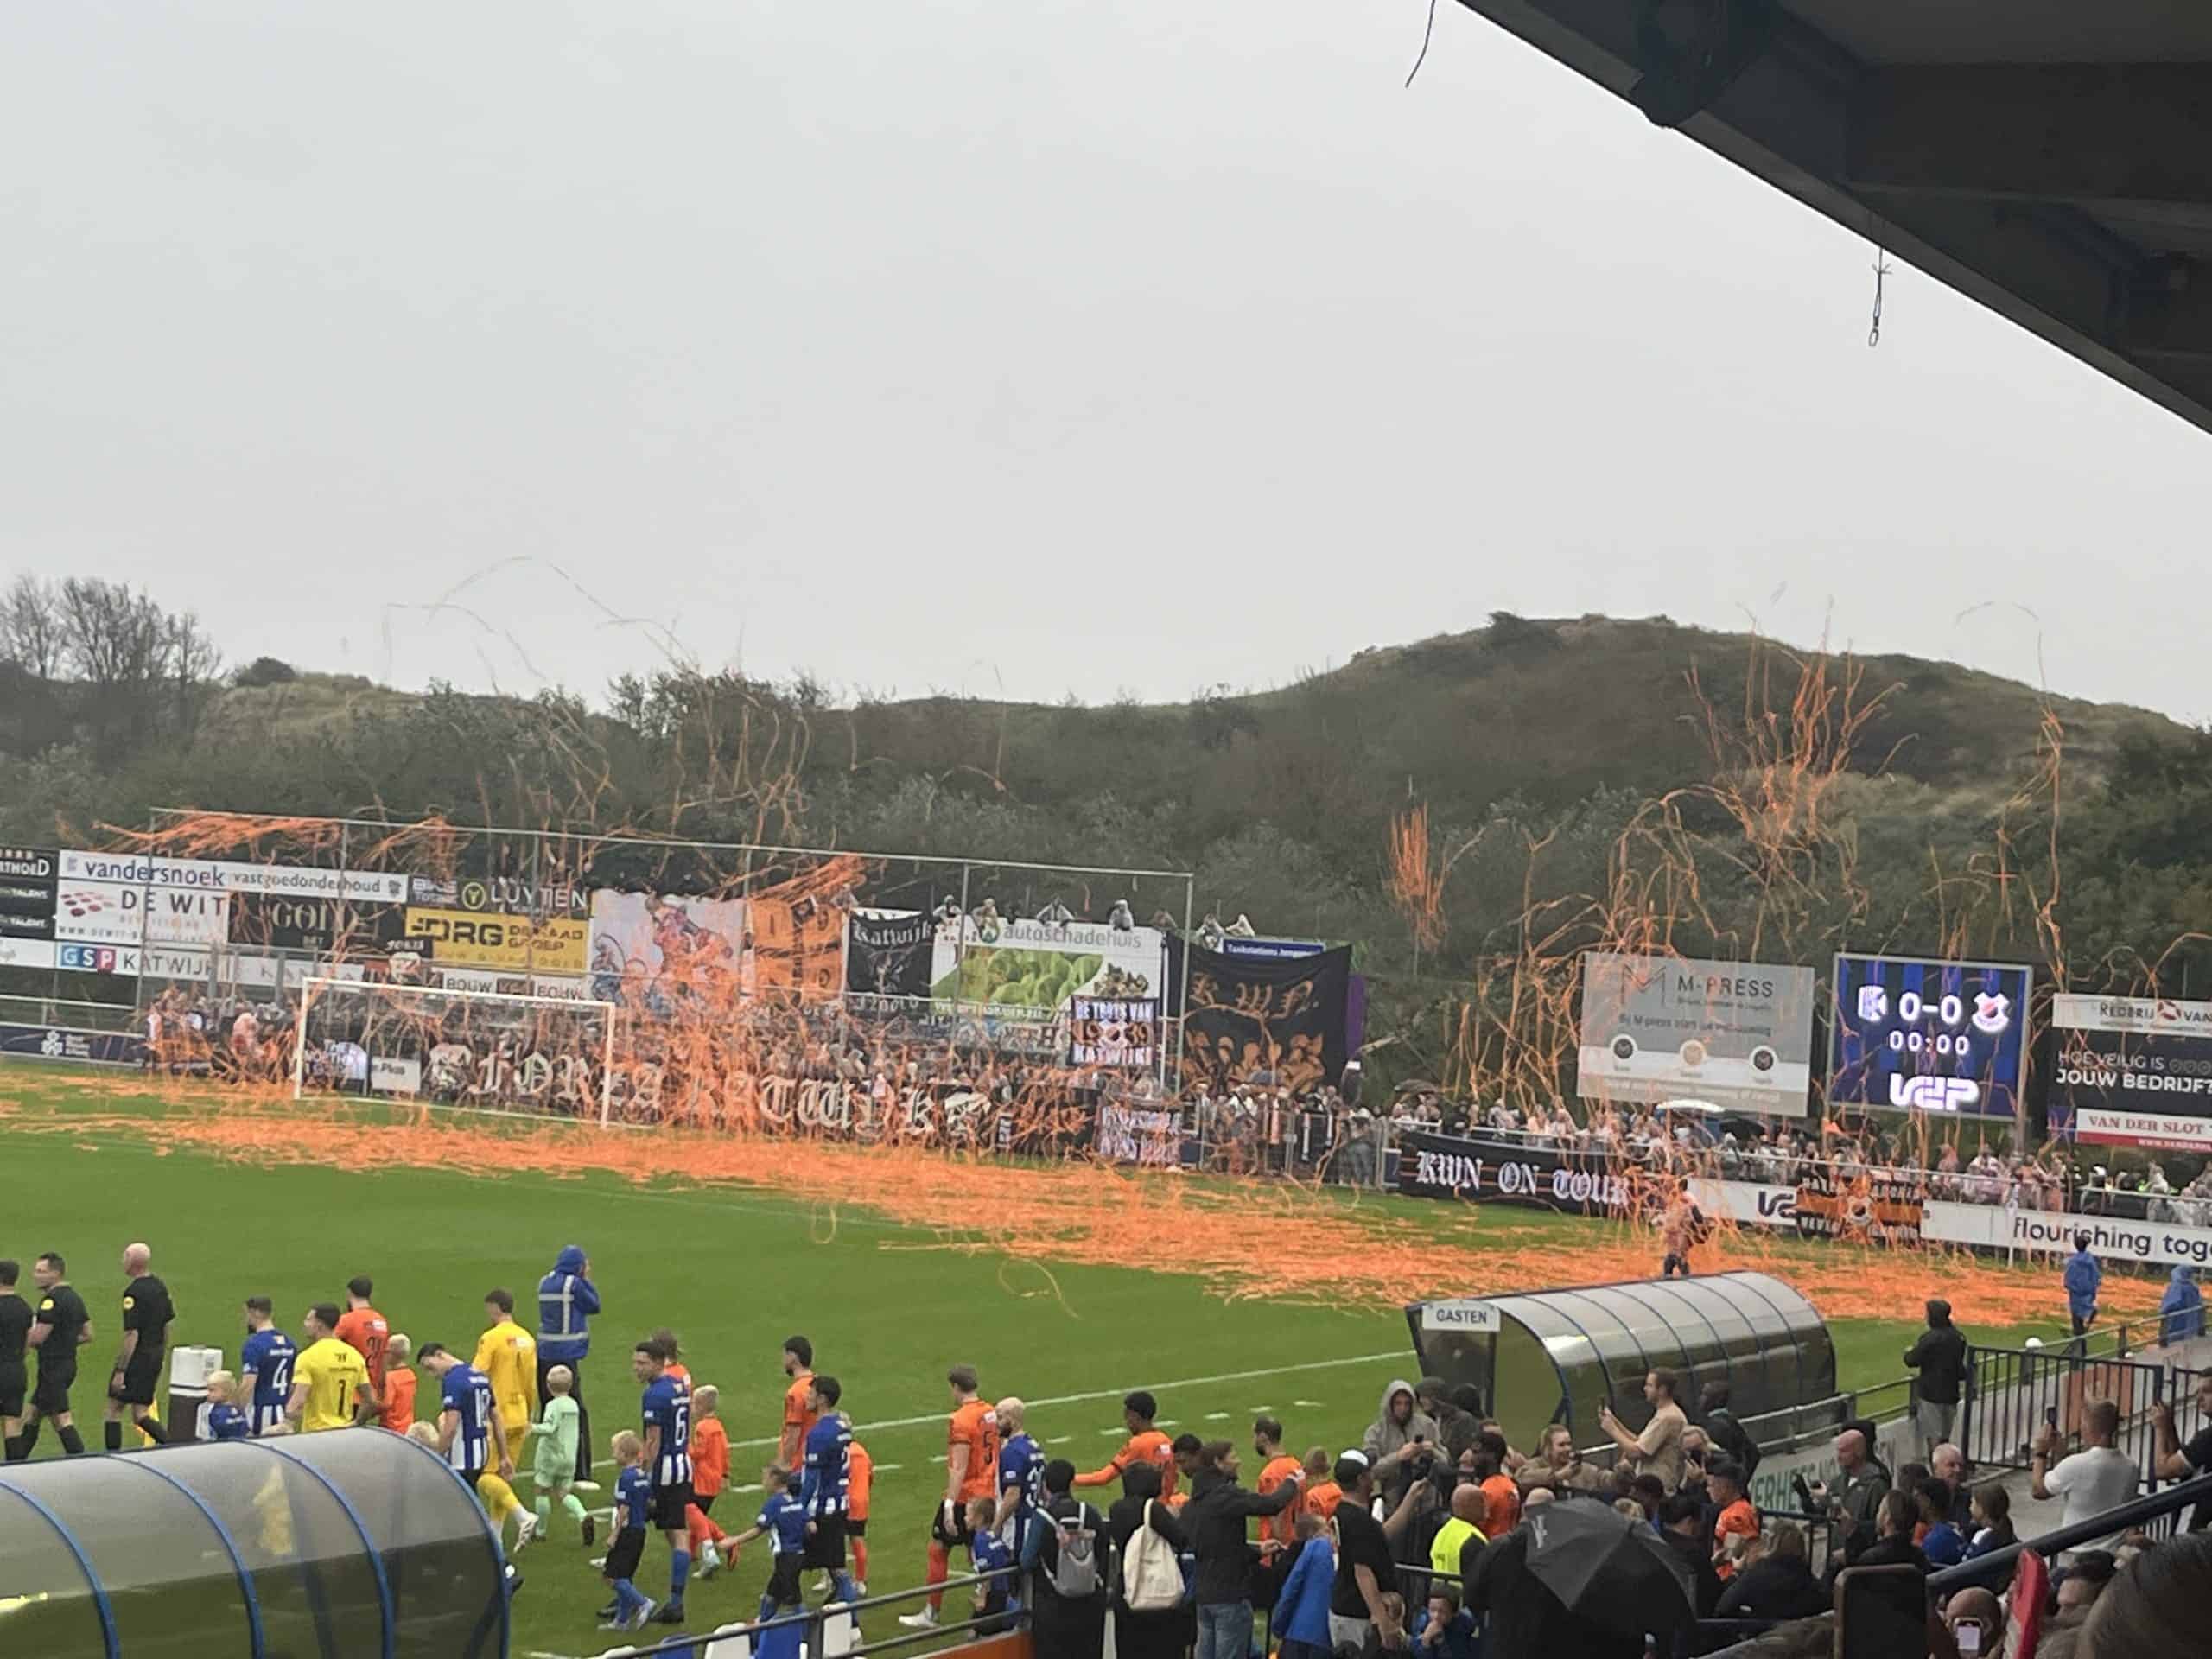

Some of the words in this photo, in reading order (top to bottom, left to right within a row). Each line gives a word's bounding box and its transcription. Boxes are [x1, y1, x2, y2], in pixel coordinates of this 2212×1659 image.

[85, 860, 226, 887] vandersnoek
[122, 890, 156, 912] DE
[169, 893, 226, 916] WIT
[1004, 924, 1142, 949] autoschadehuis
[62, 946, 116, 971] GSP
[1677, 975, 1775, 998] M-PRESS
[1898, 991, 1963, 1026] 0-0
[1888, 1030, 1971, 1056] 00:00
[2150, 1056, 2164, 1071] IS
[2056, 1068, 2118, 1088] JOUW
[2088, 1115, 2120, 1129] VAN
[2125, 1118, 2158, 1132] DER
[2163, 1121, 2205, 1135] SLOT
[1497, 1160, 1541, 1197] ON
[1553, 1168, 1630, 1206] TOUR
[1436, 1308, 1487, 1325] GASTEN
[272, 1357, 289, 1397] 4
[676, 1406, 688, 1446] 6
